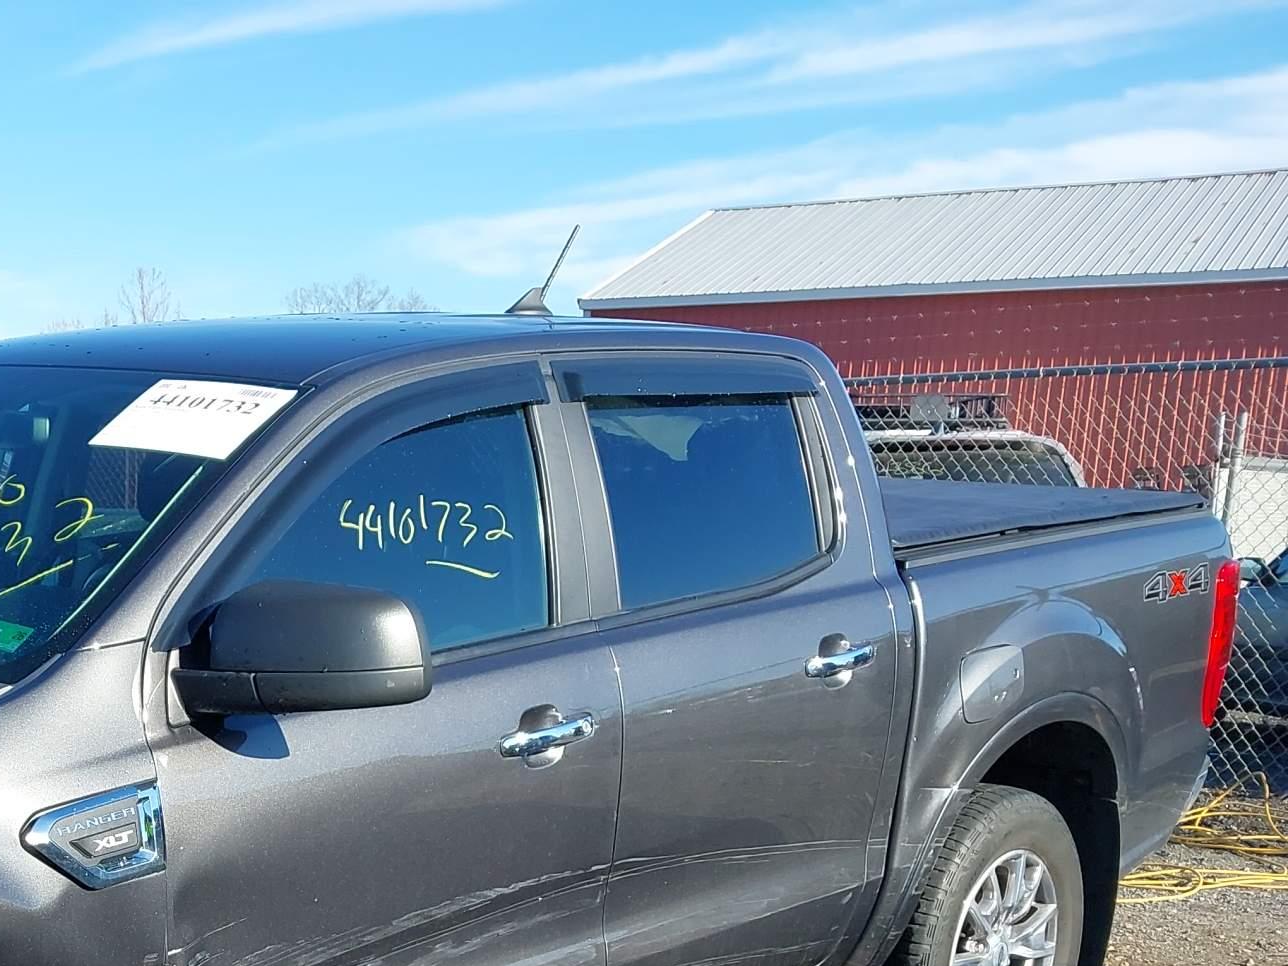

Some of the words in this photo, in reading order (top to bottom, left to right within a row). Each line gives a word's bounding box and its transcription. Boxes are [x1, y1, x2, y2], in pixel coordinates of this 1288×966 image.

[149, 393, 260, 415] 44101732
[339, 494, 514, 551] 44101732
[93, 829, 134, 853] XLT
